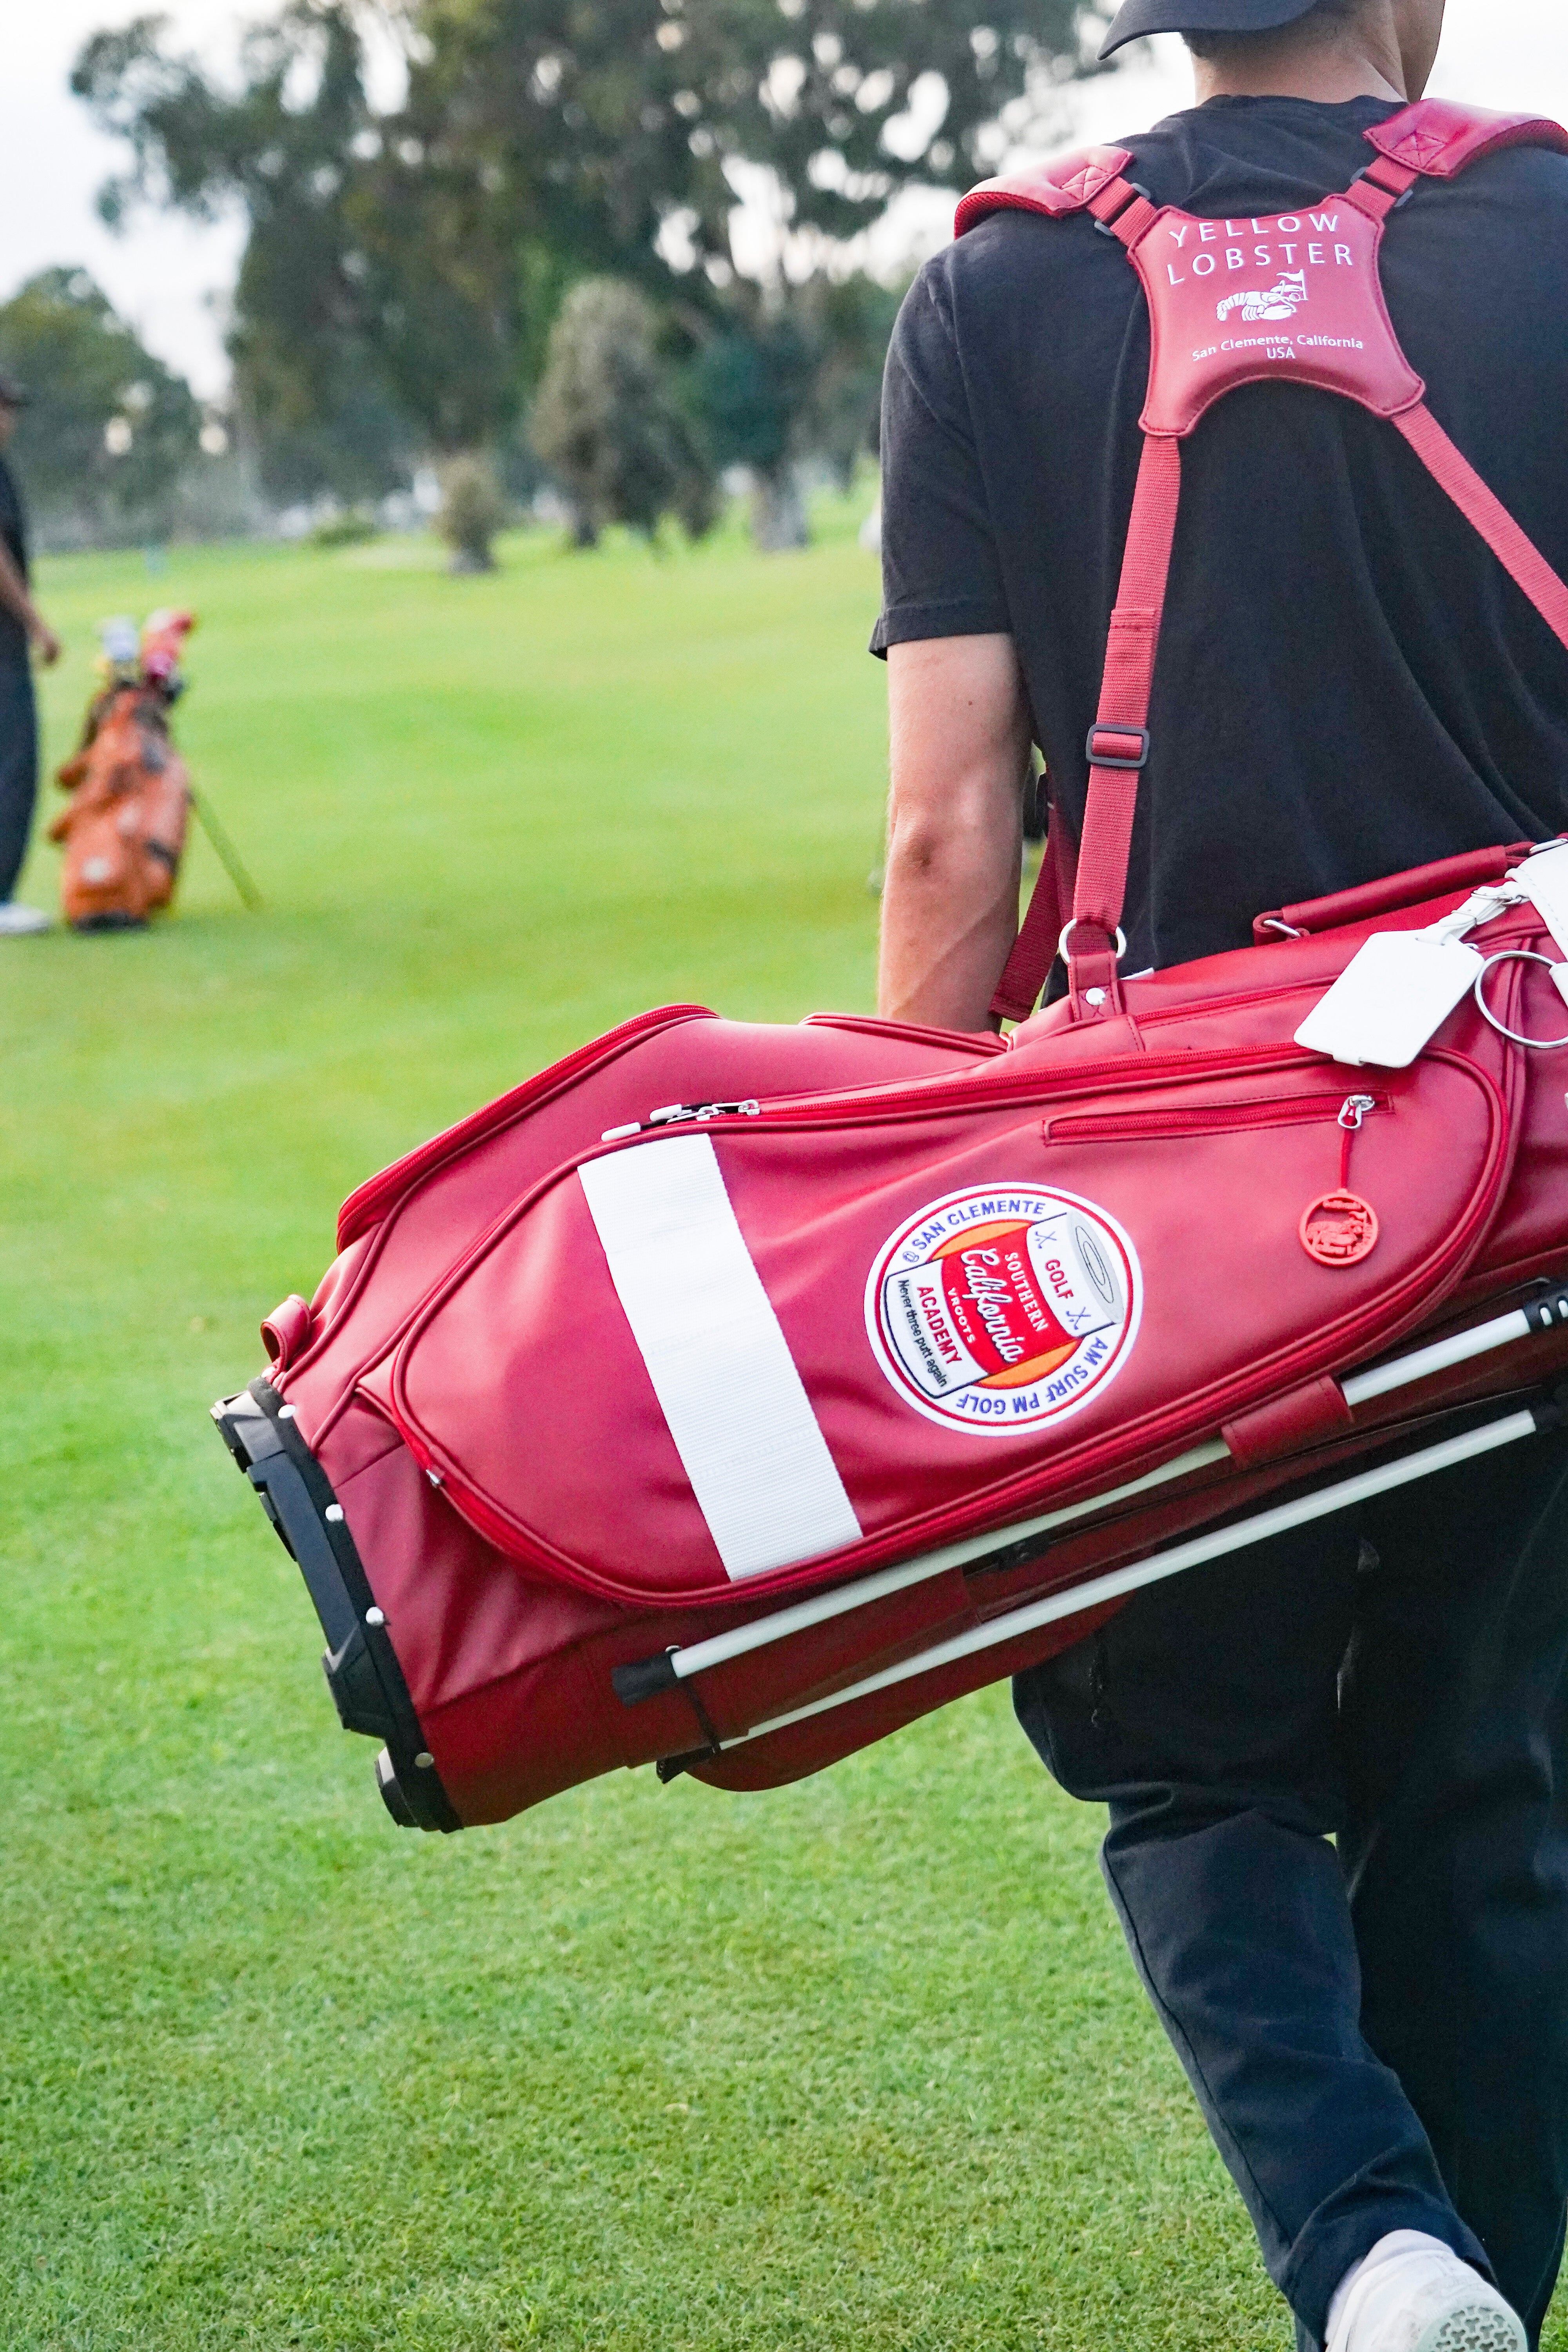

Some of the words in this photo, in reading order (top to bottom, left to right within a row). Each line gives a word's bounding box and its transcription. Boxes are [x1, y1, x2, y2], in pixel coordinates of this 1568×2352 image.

[1169, 213, 1338, 248] YELLOW
[1167, 243, 1353, 285] LOBSTER
[1192, 346, 1217, 361] San
[1220, 335, 1293, 351] Clemente,
[1296, 334, 1363, 349] California
[1266, 347, 1296, 359] USA
[912, 1222, 946, 1250] SAN
[947, 1200, 1046, 1225] CLEMENTE
[898, 1279, 912, 1308] Never
[1004, 1252, 1049, 1332] SOUTHERN
[1045, 1259, 1074, 1299] GOLF
[947, 1287, 976, 1343] VROOTS
[960, 1248, 1025, 1363] California
[906, 1309, 922, 1336] three
[916, 1287, 963, 1364] ACADEMY
[913, 1336, 933, 1359] putt
[1083, 1337, 1108, 1366] AM
[926, 1359, 947, 1387] again
[1045, 1365, 1088, 1403] SURF
[956, 1393, 1006, 1415] GOLF
[1012, 1392, 1040, 1414] PM
